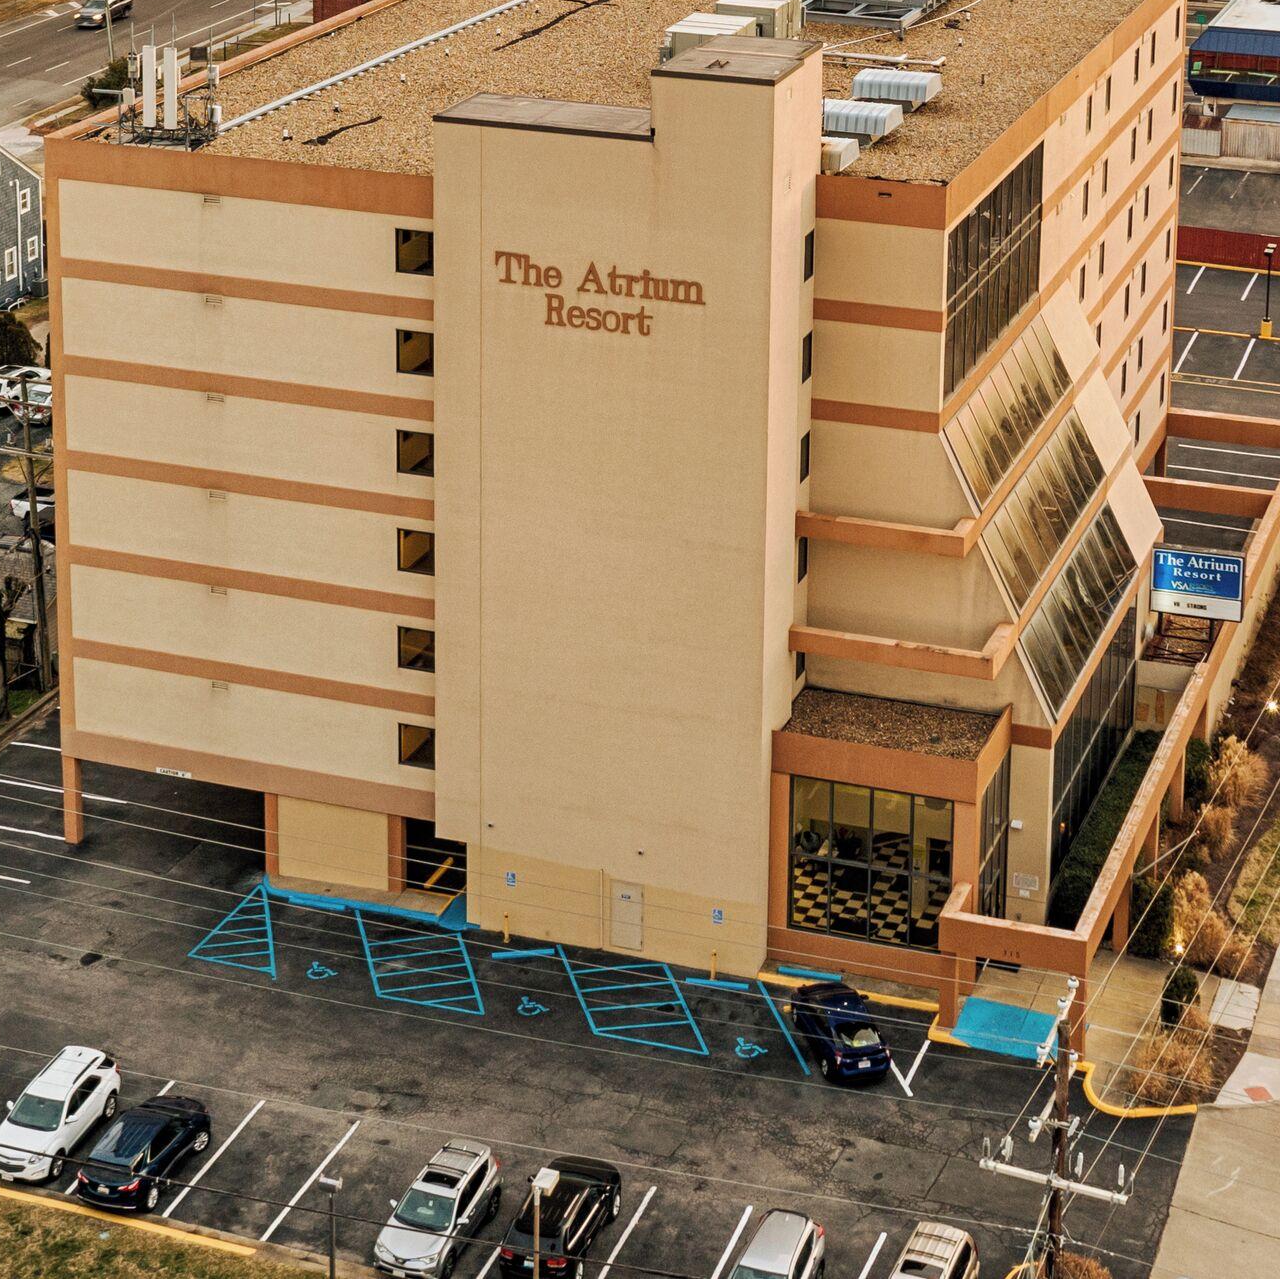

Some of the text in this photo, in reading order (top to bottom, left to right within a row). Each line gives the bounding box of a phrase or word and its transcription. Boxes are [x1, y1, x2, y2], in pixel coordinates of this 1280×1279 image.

[495, 250, 706, 305] The Atrium
[544, 293, 653, 336] Resort
[1156, 552, 1239, 573] The Atrium
[1171, 580, 1189, 590] VSA
[1173, 568, 1221, 581] Resort
